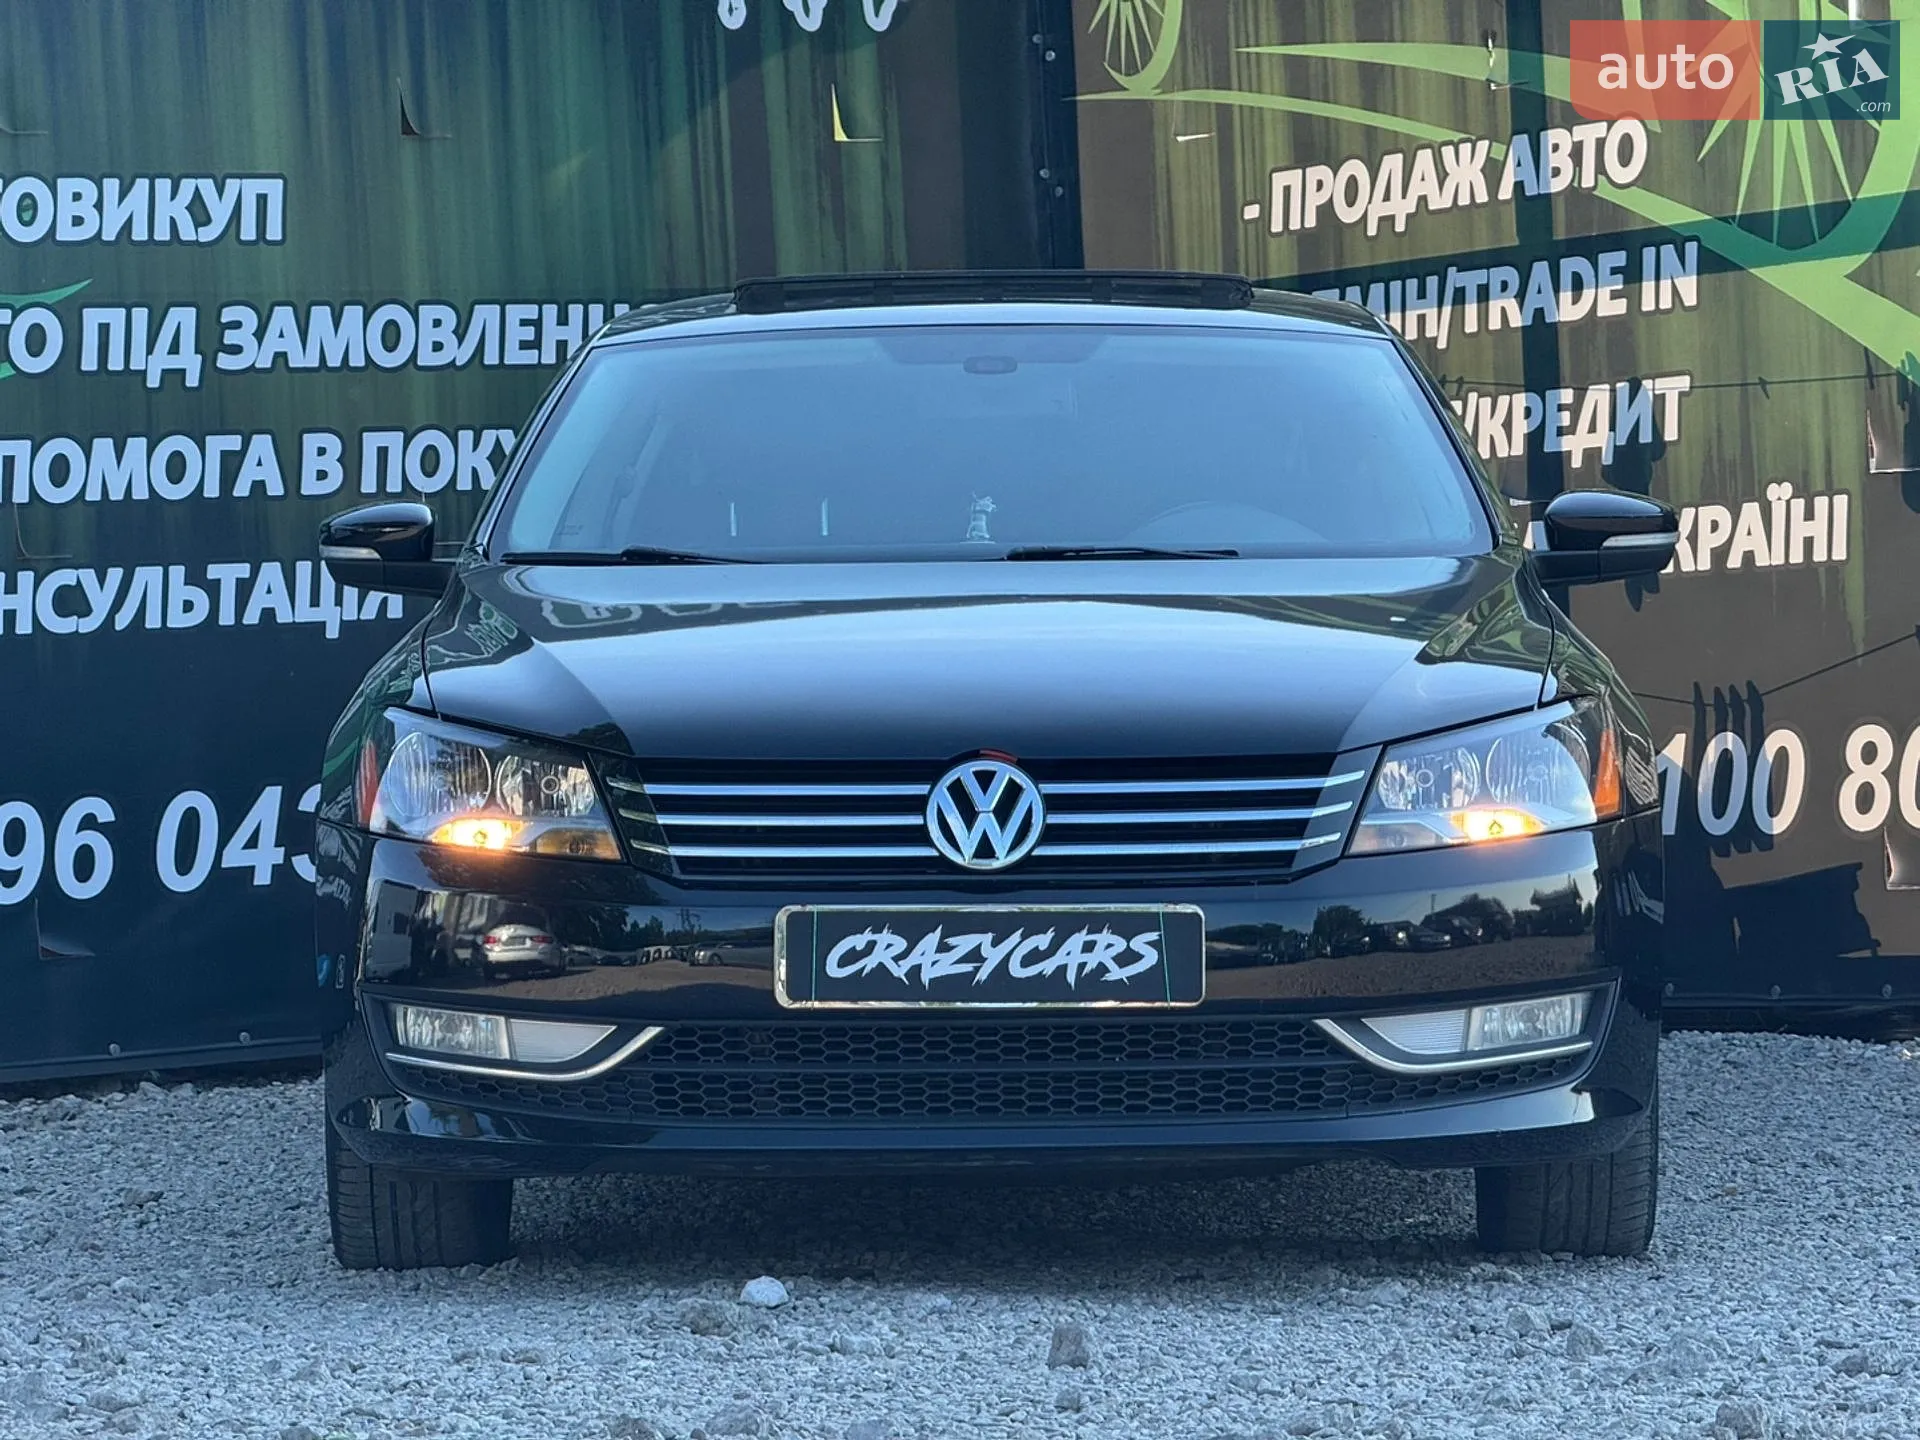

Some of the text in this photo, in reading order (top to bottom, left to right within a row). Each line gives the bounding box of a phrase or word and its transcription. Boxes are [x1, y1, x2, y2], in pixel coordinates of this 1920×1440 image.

[0, 176, 284, 243] ОВИКУП
[1270, 139, 1490, 236] ПРОДАЖ
[1498, 117, 1647, 200] АВТО
[1642, 241, 1698, 312] IN
[80, 306, 202, 388] ПІД
[216, 303, 660, 371] ЗАМОВЛЕН
[300, 431, 343, 493] В
[1450, 375, 1691, 468] /КРЕДИТ
[1659, 482, 1848, 574] КРАЇНІ
[1656, 728, 1805, 836] 100
[825, 922, 1162, 991] CRAZYCARS
